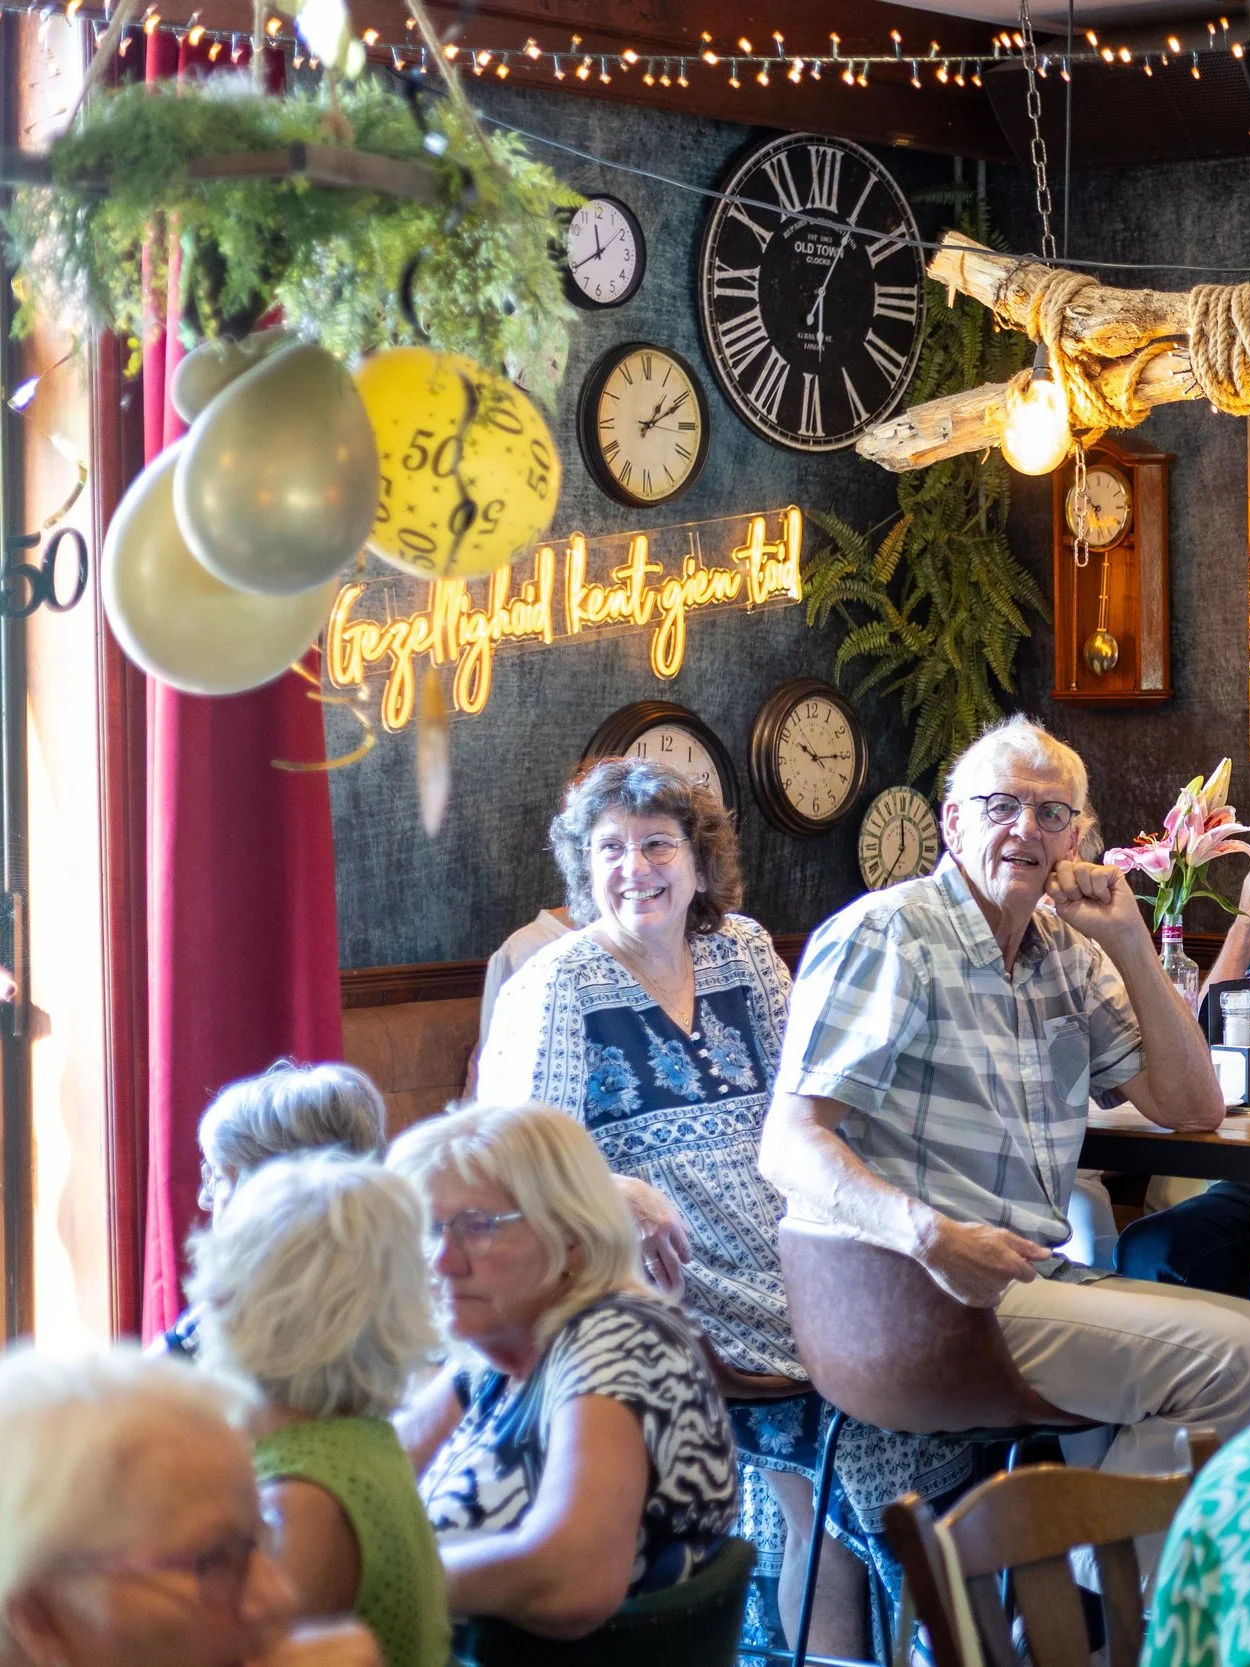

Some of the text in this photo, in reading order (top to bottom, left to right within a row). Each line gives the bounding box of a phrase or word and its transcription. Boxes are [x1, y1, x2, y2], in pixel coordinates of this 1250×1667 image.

[761, 151, 804, 222] XI
[807, 146, 845, 214] XII
[846, 172, 880, 226] I
[581, 211, 589, 224] 11
[594, 206, 603, 219] 12
[610, 214, 615, 226] 1
[571, 223, 581, 236] 10
[619, 229, 626, 241] 2
[794, 241, 844, 259] OLD TOWN
[865, 222, 909, 268] II
[624, 249, 630, 262] 3
[806, 256, 831, 266] CLOCKS
[619, 269, 626, 280] 4
[713, 257, 760, 302] IX
[583, 277, 590, 290] 7
[594, 284, 602, 297] 6
[609, 280, 616, 293] 5
[874, 283, 918, 325] III
[718, 311, 770, 382] VIII
[747, 346, 790, 424] VII
[798, 373, 825, 436] VI
[841, 367, 871, 427] V
[678, 422, 696, 430] III
[402, 427, 464, 478] 50
[526, 438, 551, 501] 50
[0, 527, 89, 619] 50
[569, 534, 663, 634] kent
[651, 558, 743, 678] gien
[790, 710, 801, 726] 11
[805, 702, 819, 719] 12
[824, 708, 832, 724] 1
[780, 728, 792, 744] 10
[834, 725, 846, 739] 2
[637, 742, 647, 758] 11
[660, 735, 673, 752] 12
[688, 746, 692, 763] 1
[839, 751, 851, 761] 3
[702, 771, 710, 788] 2
[838, 773, 848, 785] 4
[795, 793, 805, 808] 7
[812, 797, 819, 814] 6
[827, 790, 836, 806] 5
